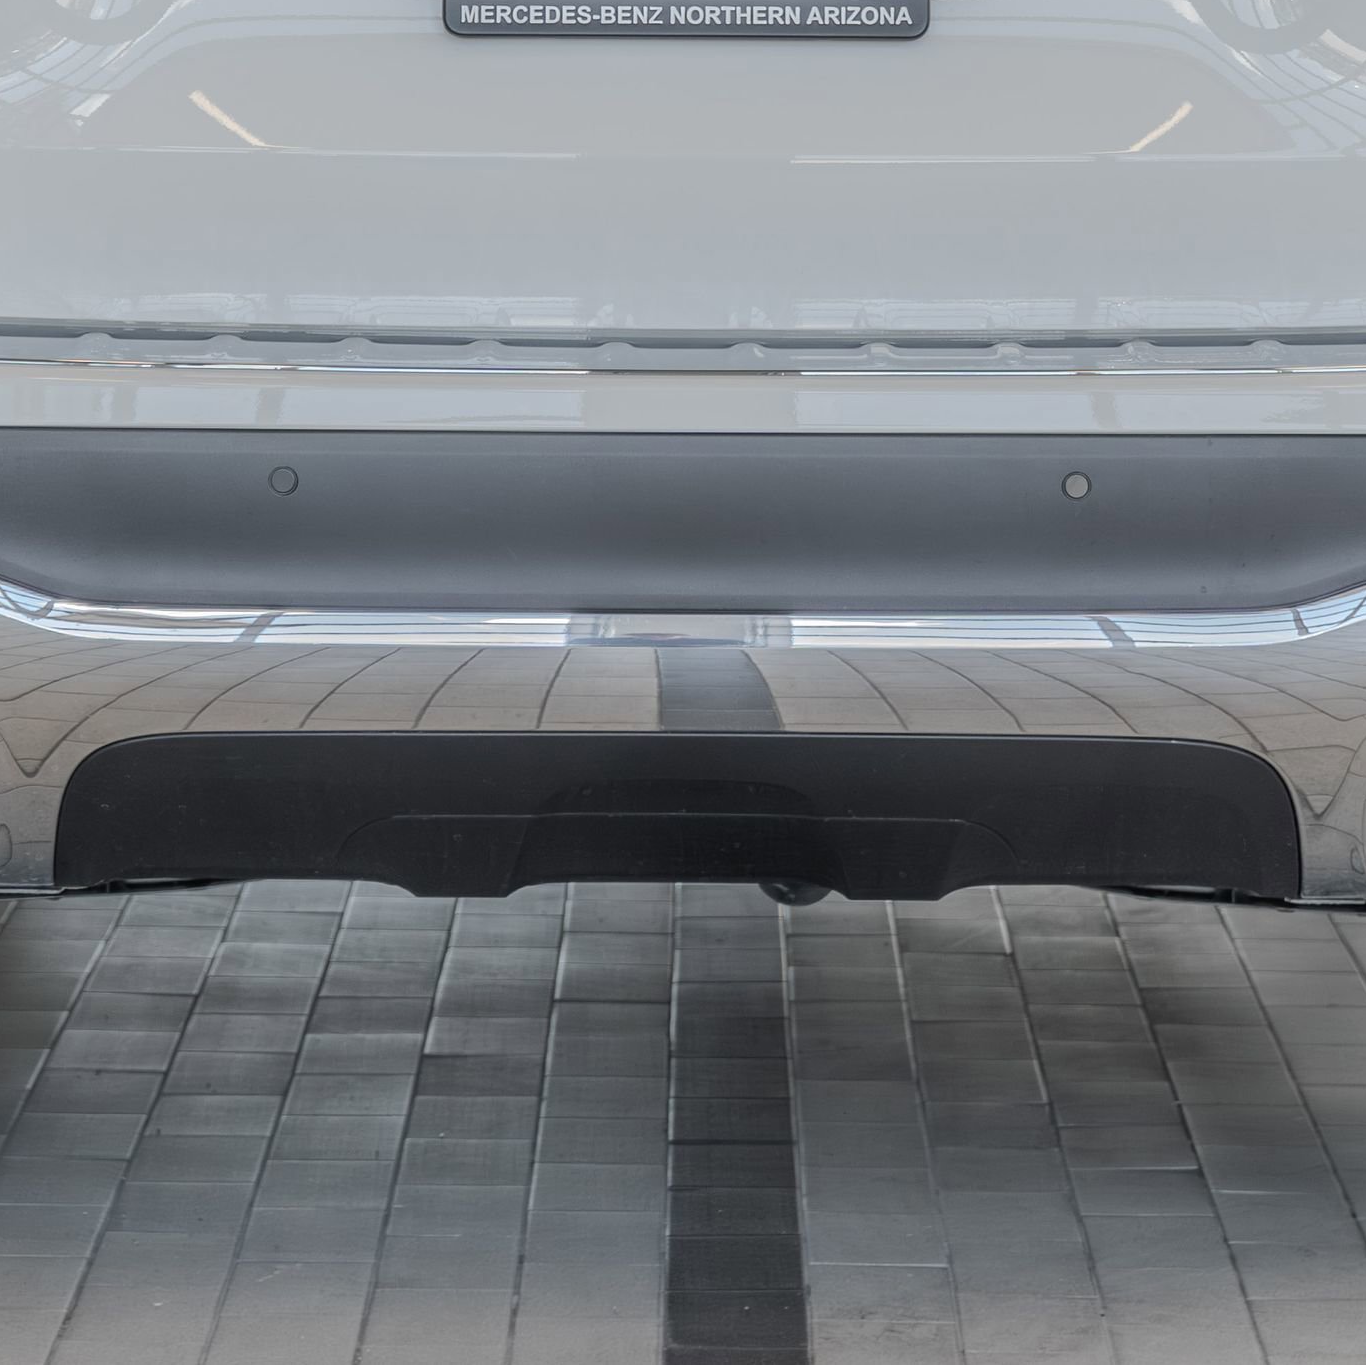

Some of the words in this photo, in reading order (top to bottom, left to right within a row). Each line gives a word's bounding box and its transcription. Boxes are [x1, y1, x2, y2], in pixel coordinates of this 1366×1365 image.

[461, 5, 663, 24] MERCEDES-BENZ
[669, 6, 801, 25] NORTHERN
[806, 6, 913, 25] ARIZONA
